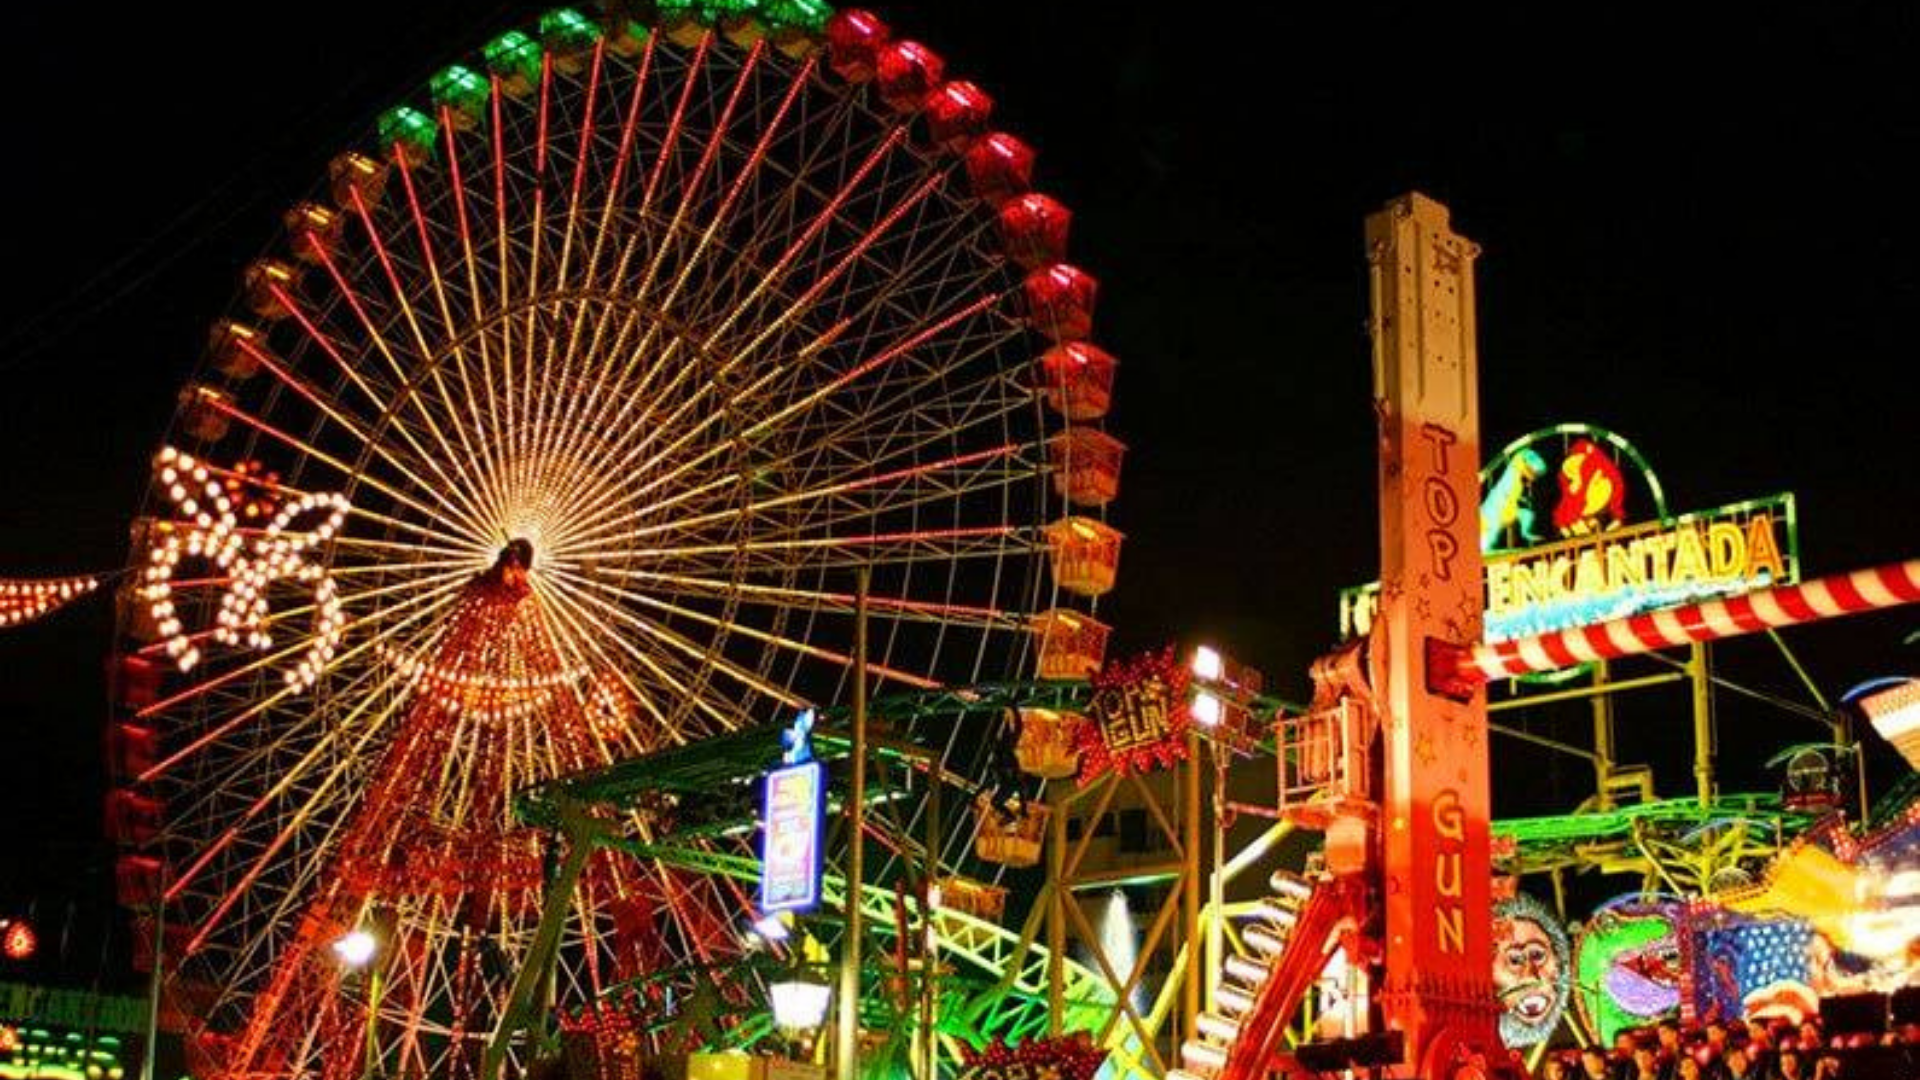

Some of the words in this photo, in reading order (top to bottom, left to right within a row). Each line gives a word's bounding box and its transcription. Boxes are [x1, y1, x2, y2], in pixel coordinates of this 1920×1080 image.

[1421, 422, 1459, 581] TOP
[1486, 514, 1784, 612] ENCANTADA
[1431, 788, 1466, 953] GUN
